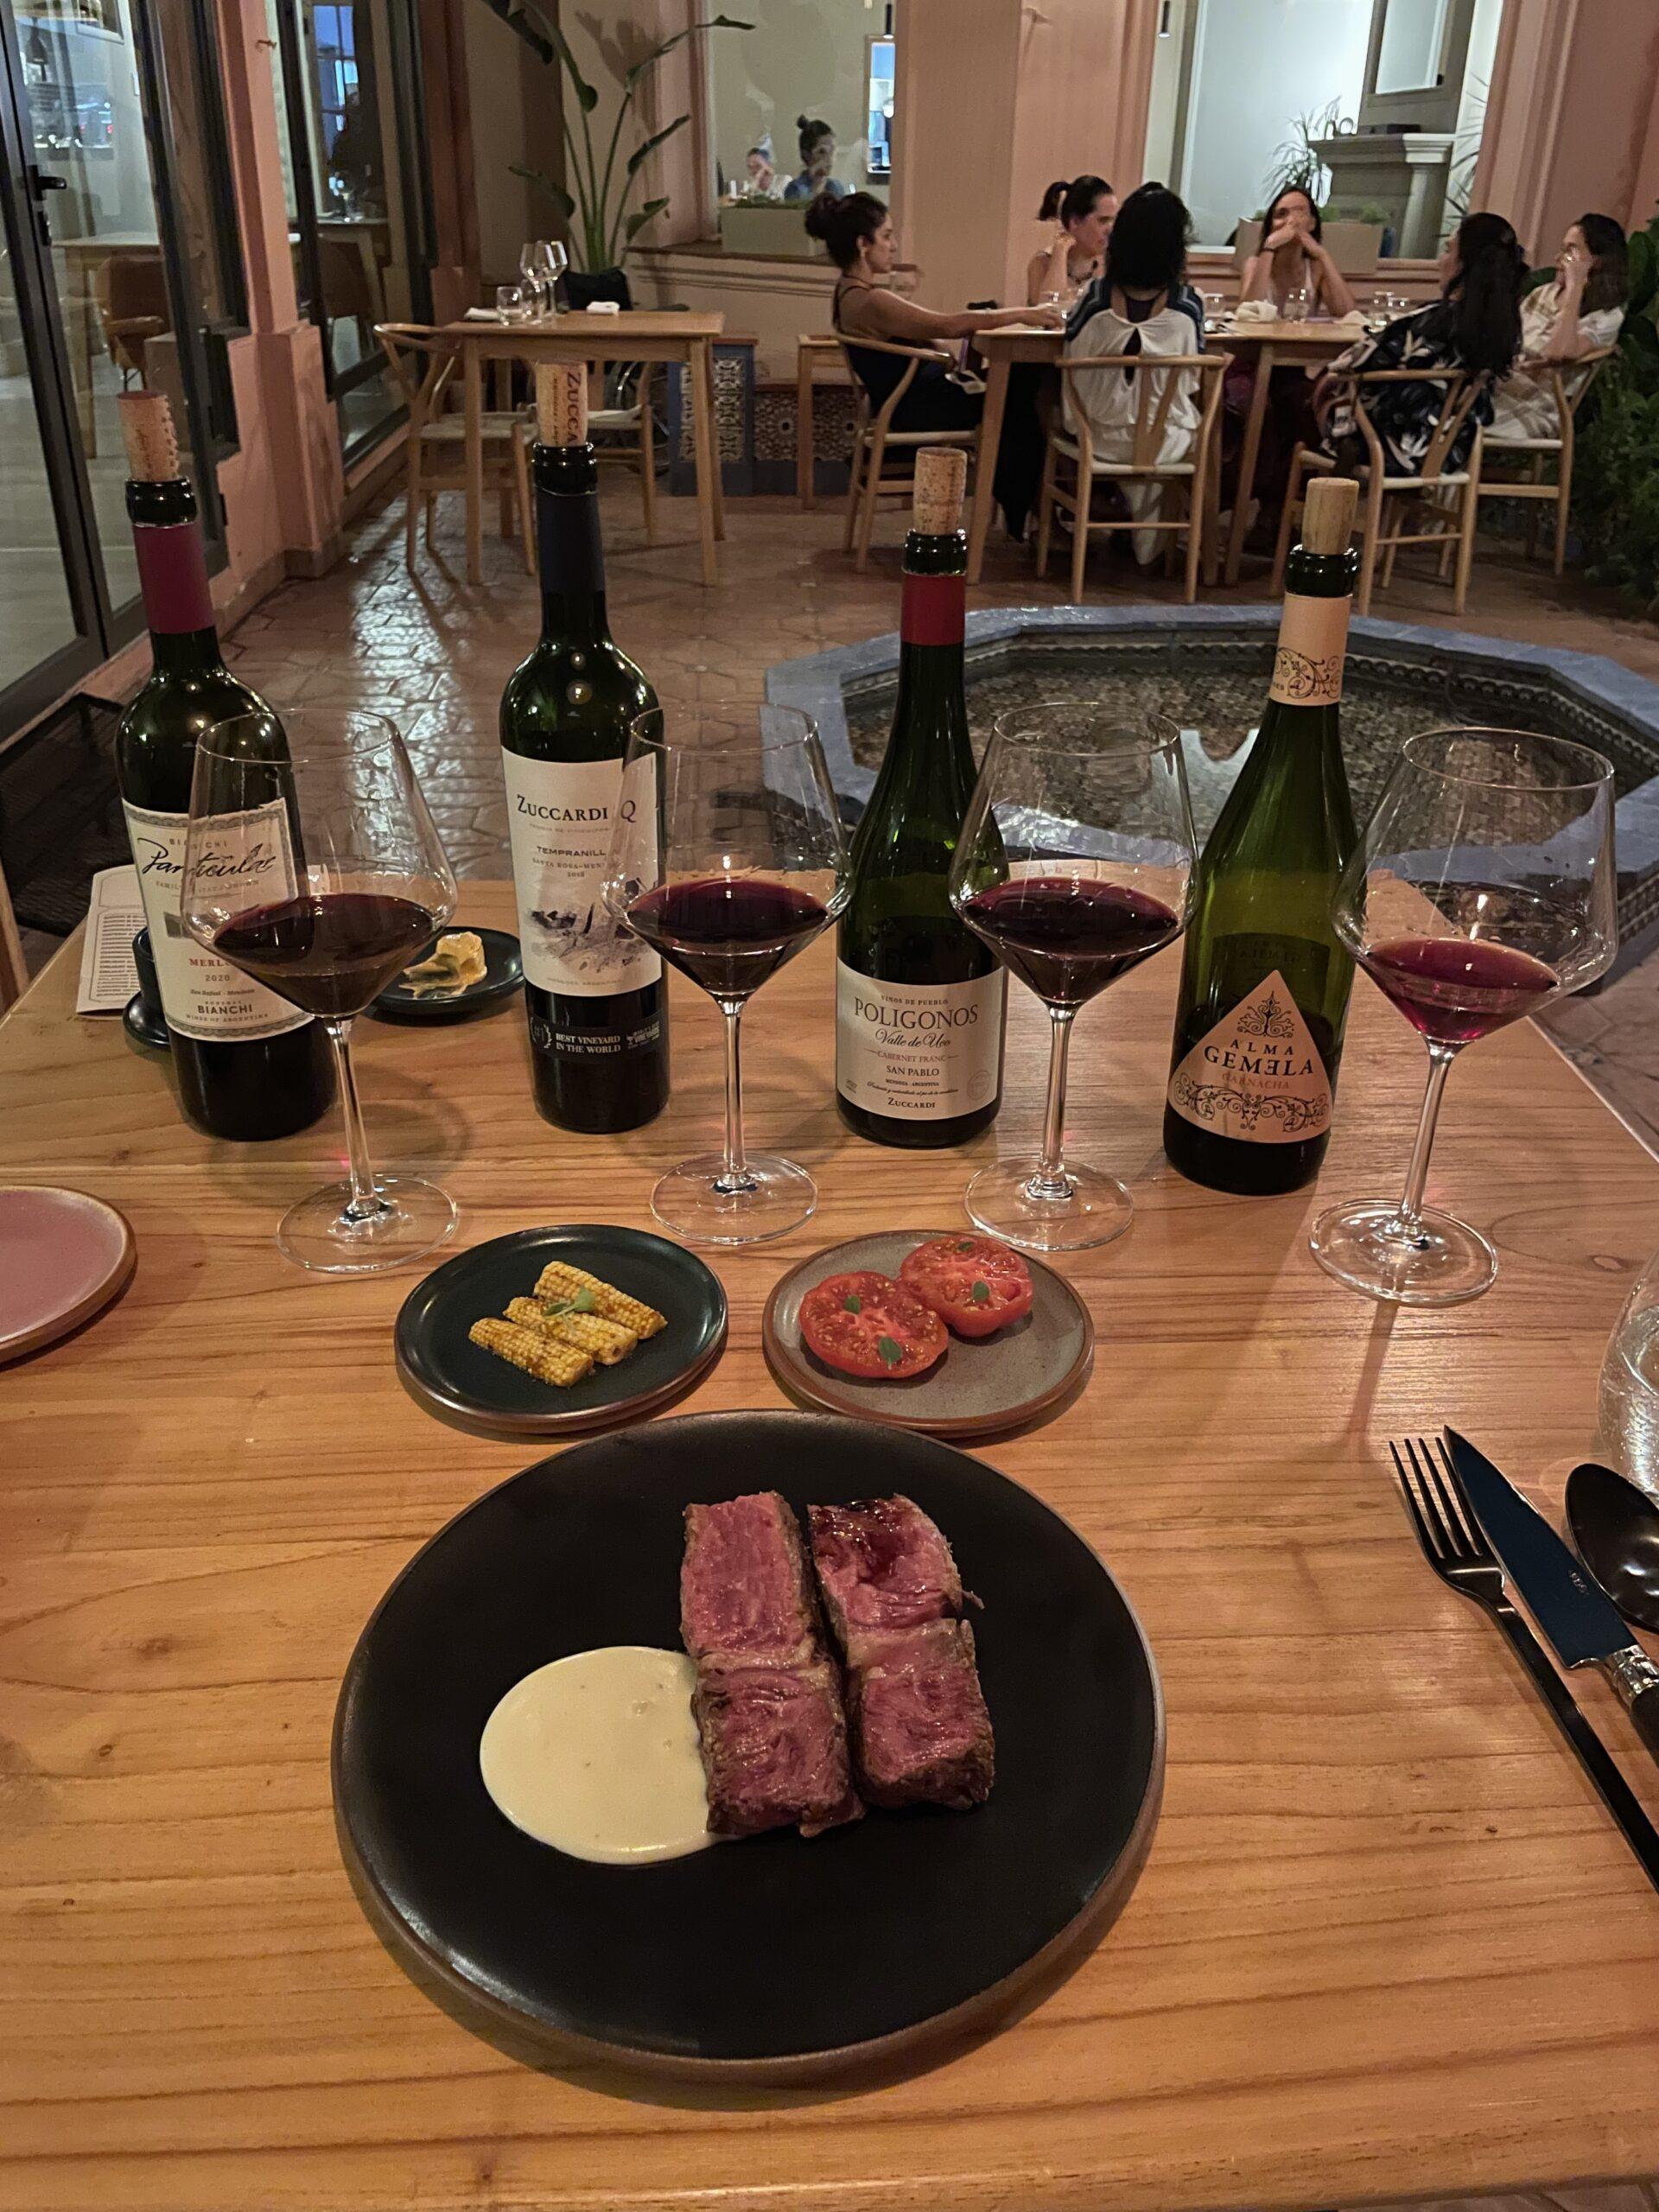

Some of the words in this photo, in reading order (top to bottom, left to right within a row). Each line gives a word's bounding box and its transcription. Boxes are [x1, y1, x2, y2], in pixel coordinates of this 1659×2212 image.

[517, 794, 608, 821] ZUCCARDI
[620, 800, 637, 823] Q
[537, 846, 607, 857] TEMPRANILL
[188, 958, 230, 967] MERL
[881, 995, 903, 1004] VINOS
[197, 1004, 253, 1014] BIANCHI
[854, 996, 979, 1029] POLIGONOS
[556, 1033, 575, 1043] BEST
[577, 1036, 620, 1045] VINEYARD
[875, 1028, 907, 1047] Valle
[907, 1036, 922, 1048] de
[922, 1033, 951, 1048] Uco
[566, 1044, 584, 1053] THE
[587, 1045, 621, 1053] WORLD
[1230, 1039, 1294, 1055] ALMA
[877, 1051, 917, 1062] CABERNET
[887, 1065, 906, 1075] SAN
[887, 1097, 936, 1109] ZUCCARDI
